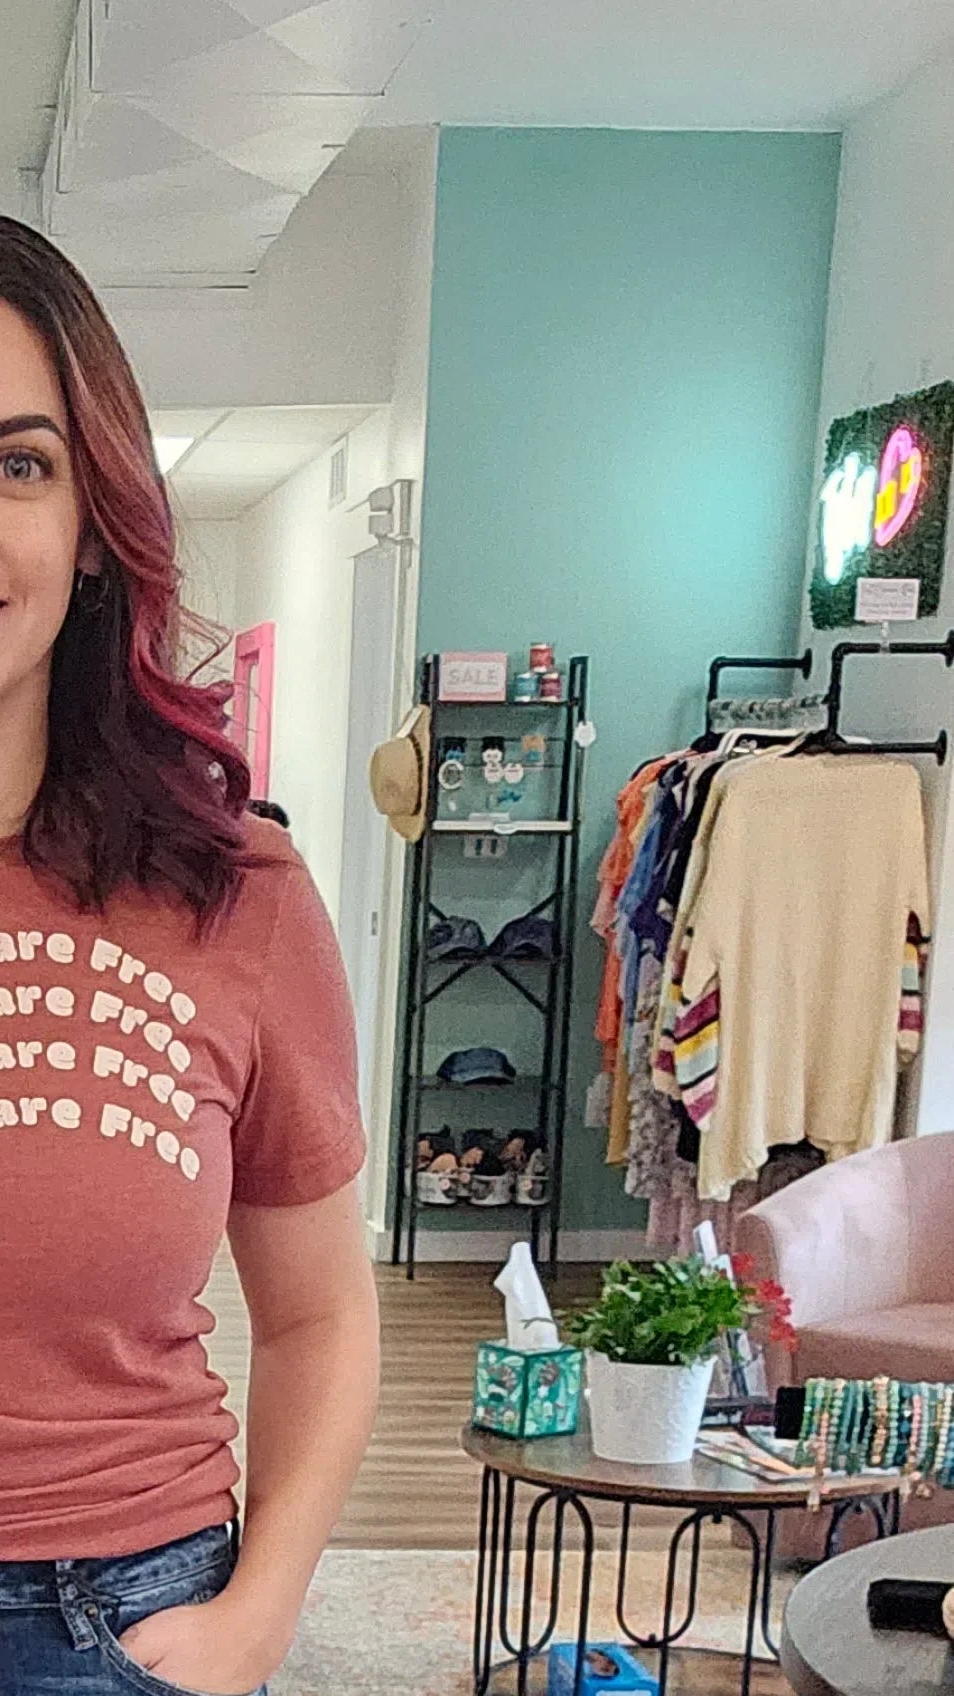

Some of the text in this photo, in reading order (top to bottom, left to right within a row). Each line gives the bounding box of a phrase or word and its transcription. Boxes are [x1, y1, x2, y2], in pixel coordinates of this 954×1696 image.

[448, 668, 499, 684] SALE
[90, 938, 197, 1025] Free
[90, 990, 192, 1073] Free
[93, 1045, 196, 1122] Free
[99, 1103, 201, 1181] Free
